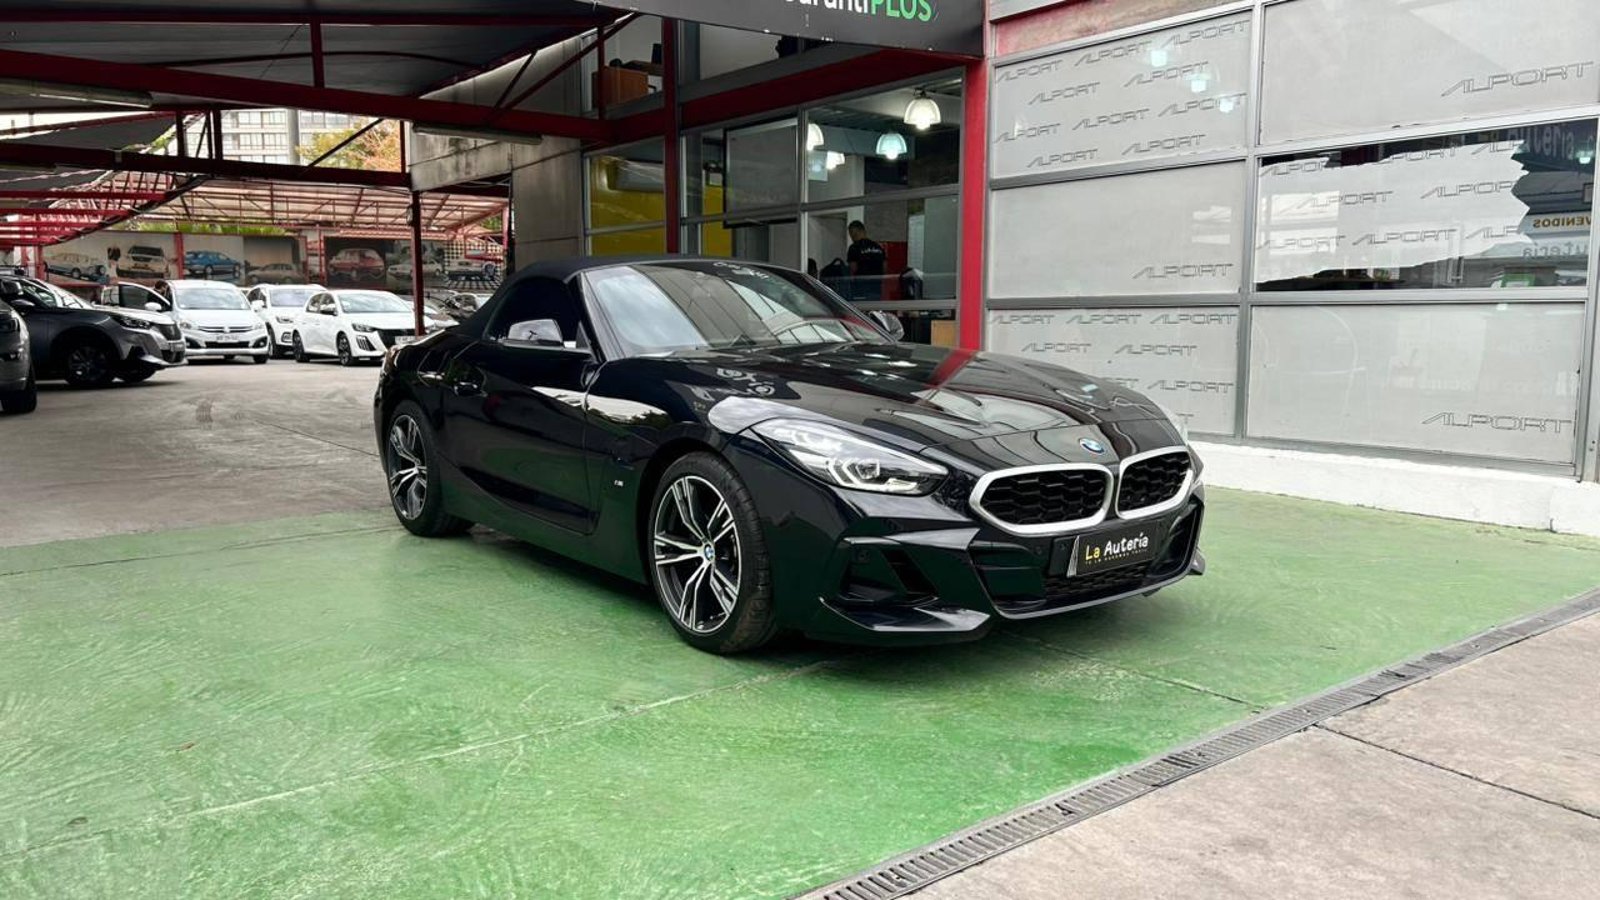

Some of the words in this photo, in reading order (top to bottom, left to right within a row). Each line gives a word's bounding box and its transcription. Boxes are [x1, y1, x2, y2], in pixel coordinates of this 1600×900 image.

[1441, 61, 1595, 97] ALPORT
[1132, 263, 1234, 280] ALPORT
[1150, 314, 1238, 325] ALPORT
[1147, 379, 1234, 394] ALPORT
[1422, 411, 1573, 434] ALPORT
[1085, 545, 1100, 561] La
[1103, 532, 1149, 556] Autería
